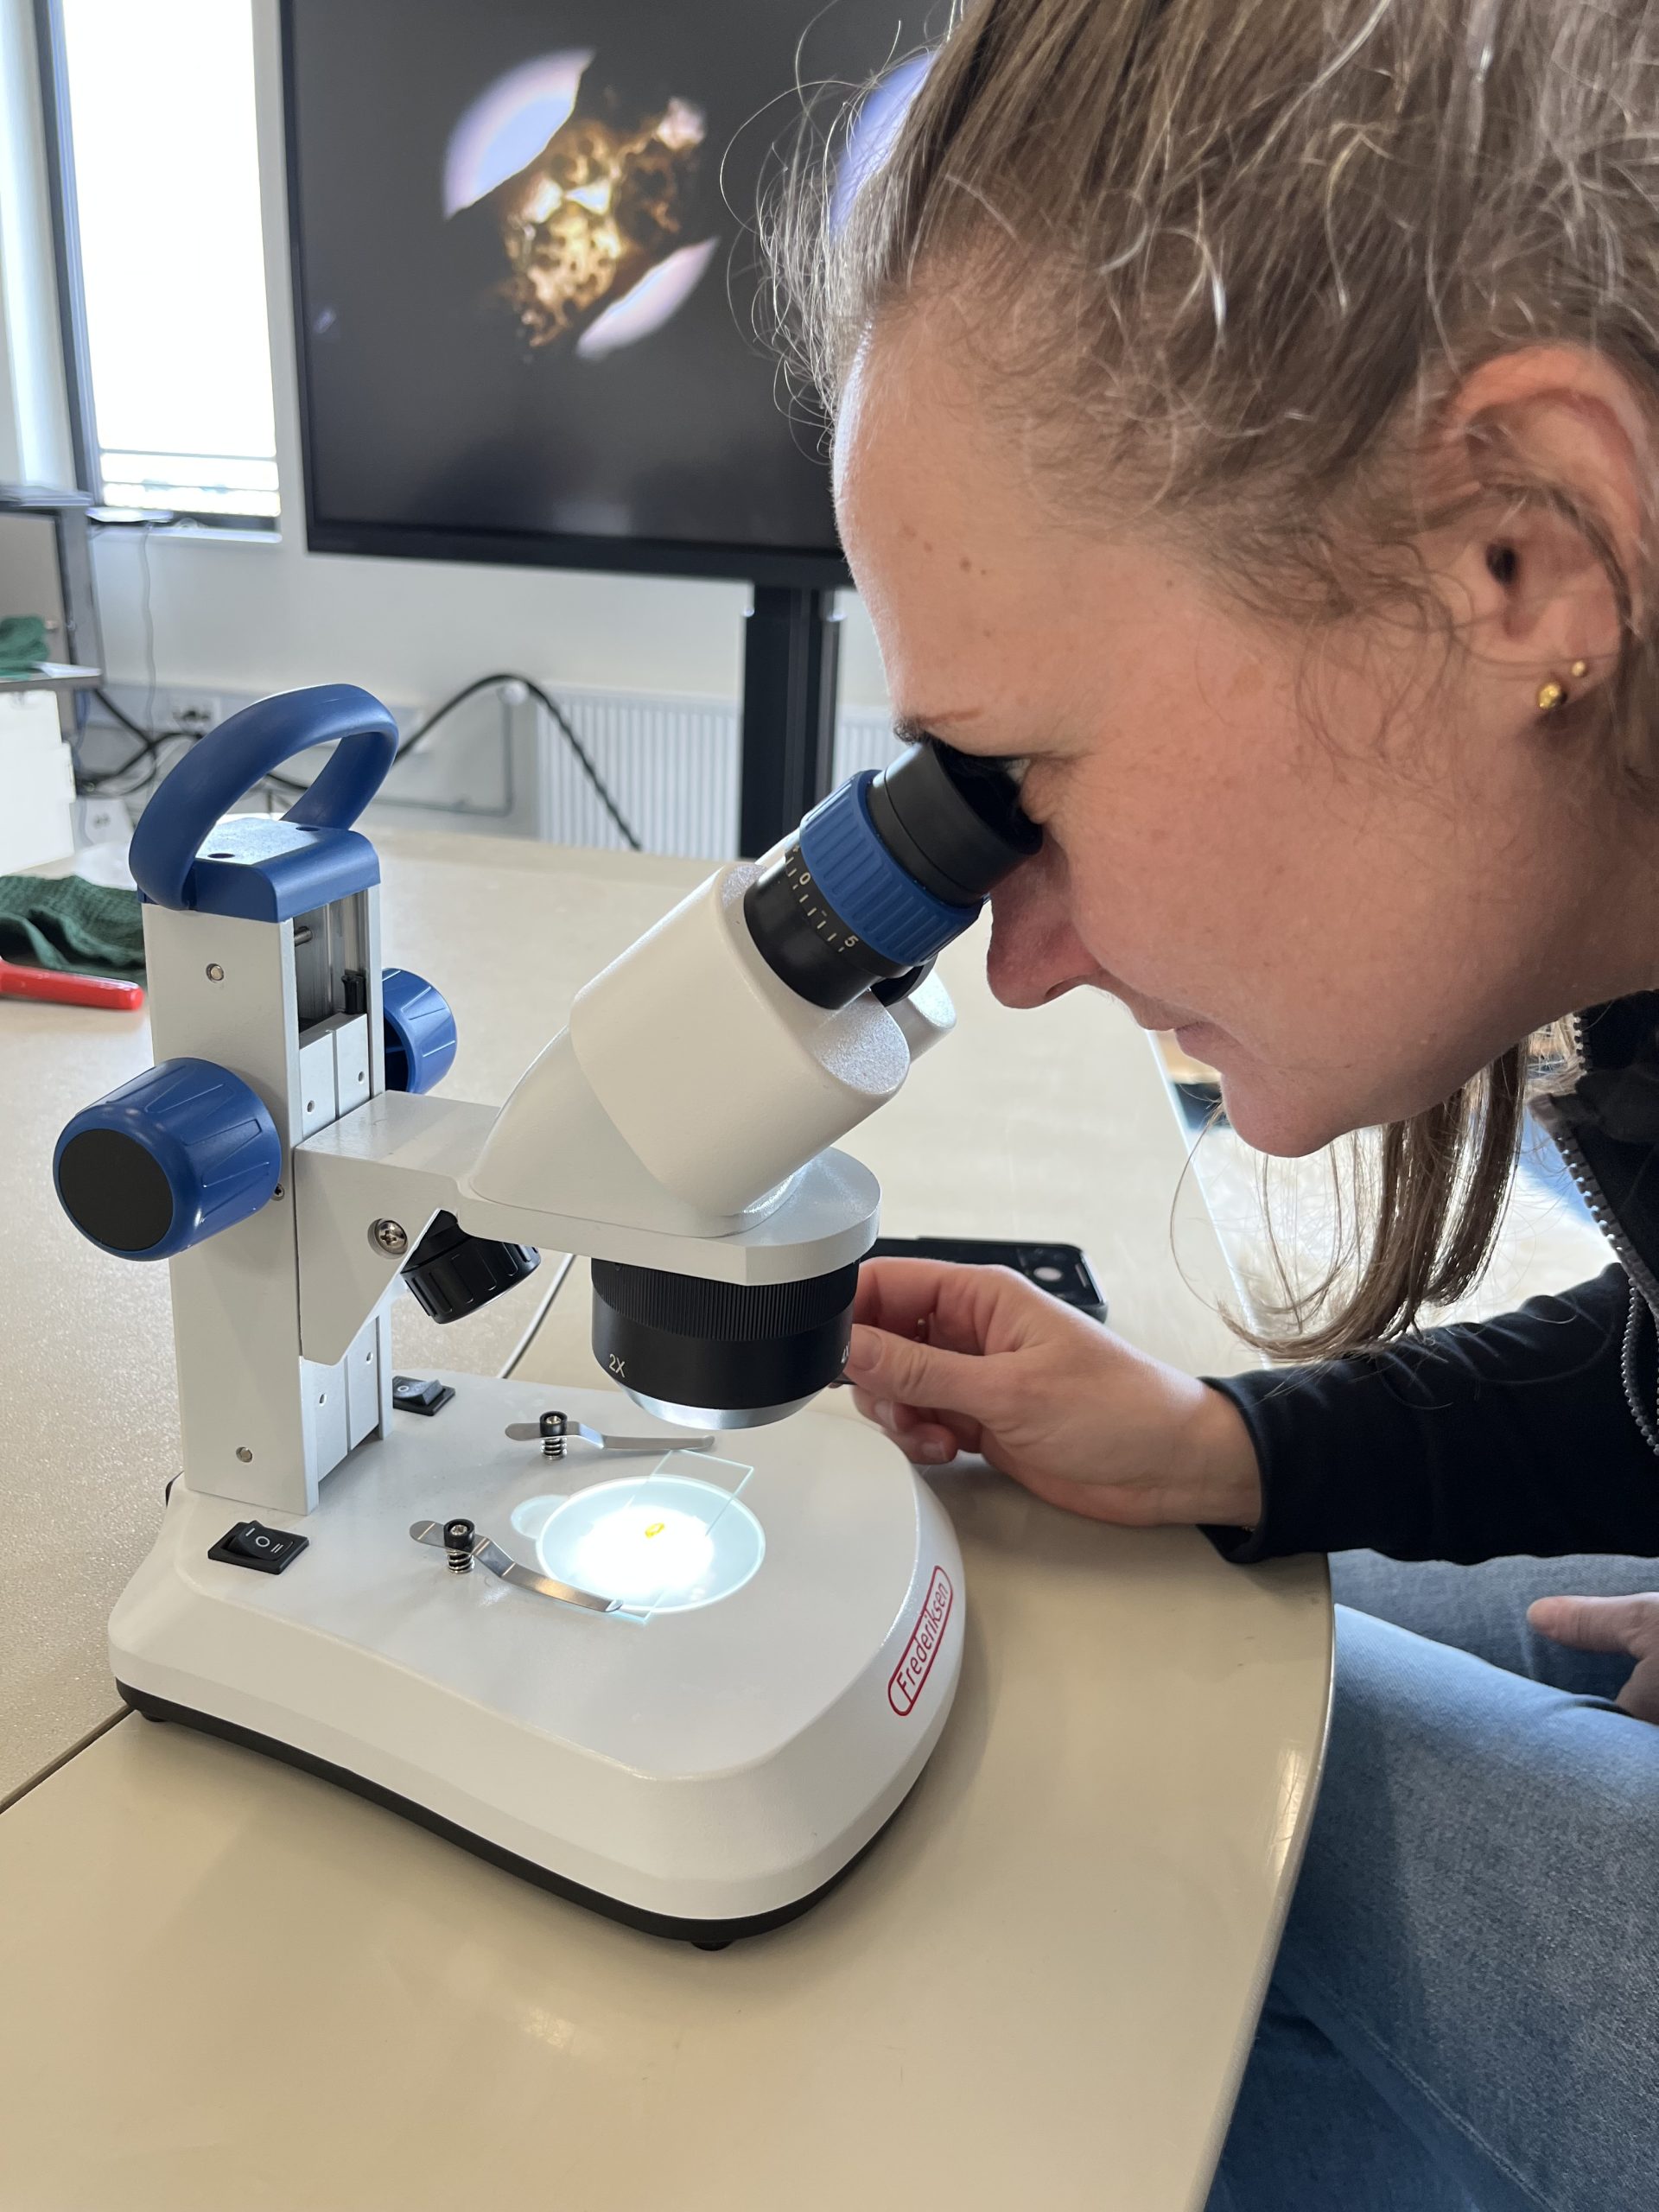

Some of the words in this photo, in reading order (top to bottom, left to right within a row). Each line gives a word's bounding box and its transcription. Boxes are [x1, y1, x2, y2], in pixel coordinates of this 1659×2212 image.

[844, 935, 859, 948] 5
[608, 1353, 626, 1378] 2X
[895, 1581, 950, 1704] Frederiksen
